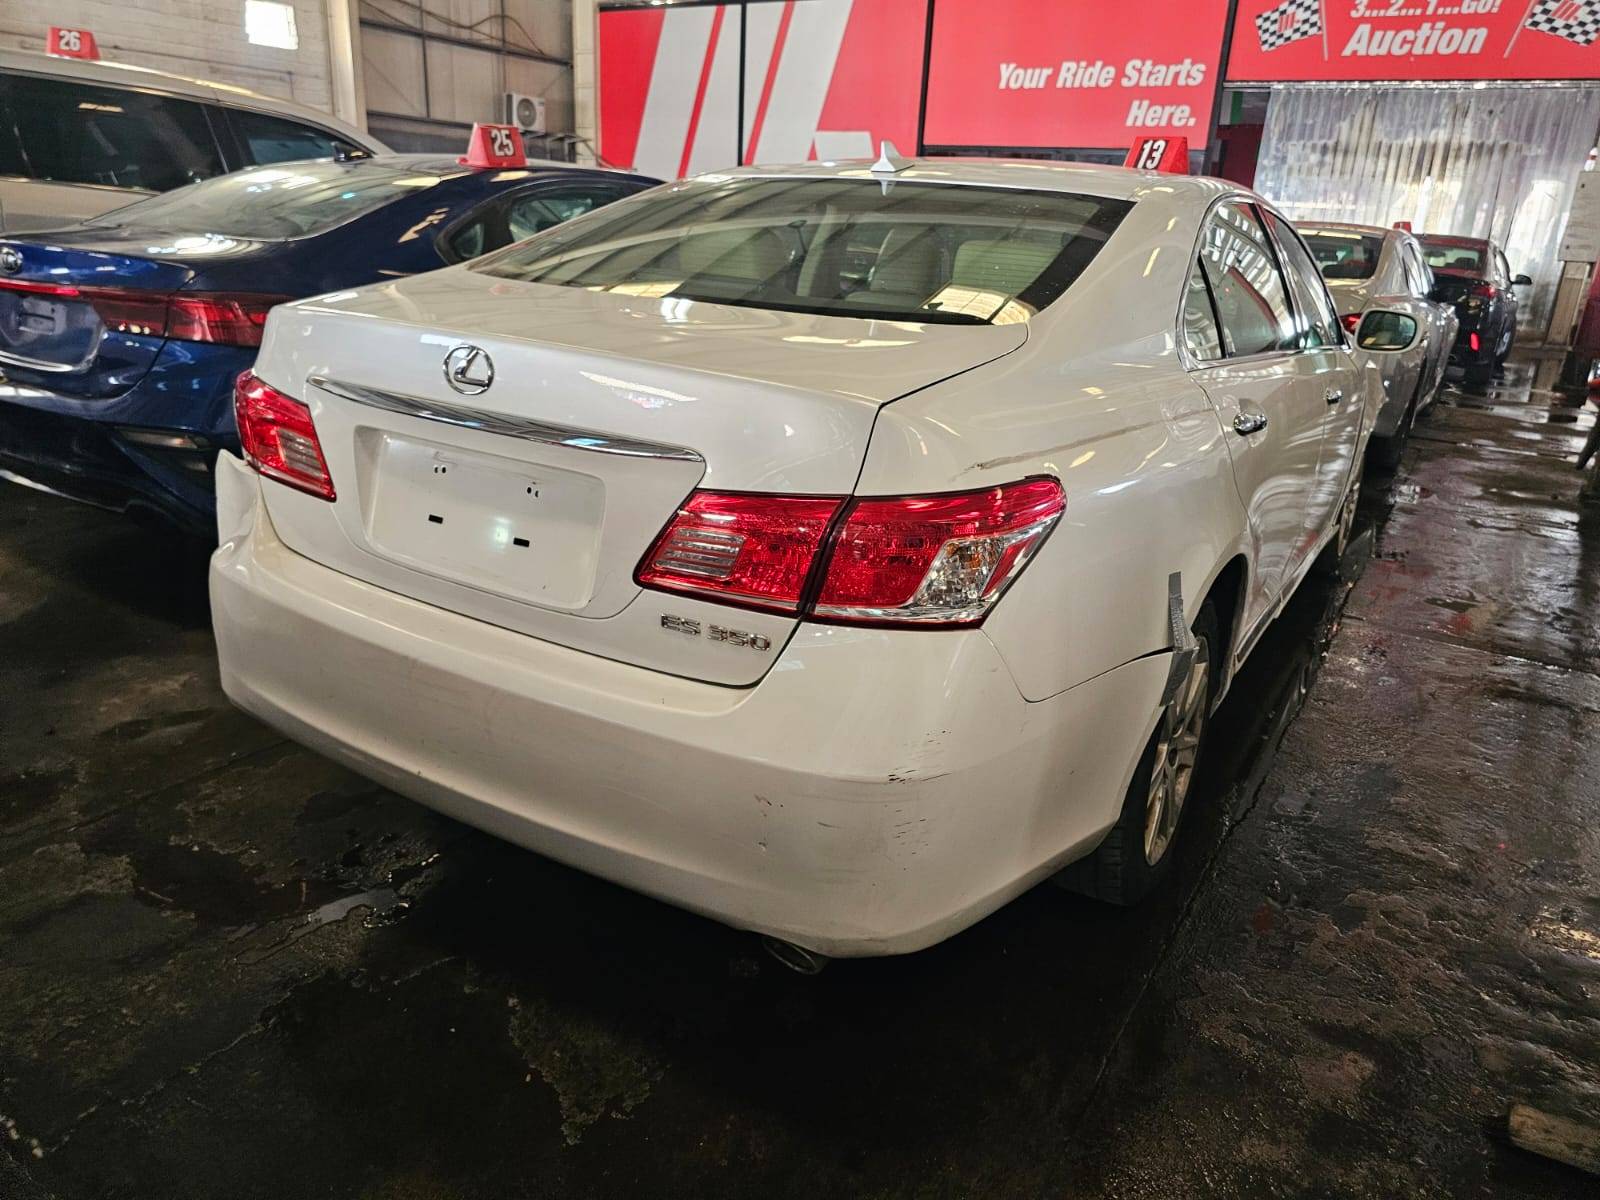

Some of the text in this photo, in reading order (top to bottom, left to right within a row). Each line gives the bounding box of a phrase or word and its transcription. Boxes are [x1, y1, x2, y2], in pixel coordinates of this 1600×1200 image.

[59, 30, 81, 51] 26
[1341, 21, 1489, 56] Auction
[999, 58, 1206, 89] Your Ride Starts
[1125, 99, 1196, 127] Here.
[491, 128, 514, 156] 25
[1137, 139, 1166, 170] 13
[661, 613, 771, 651] ES 350
